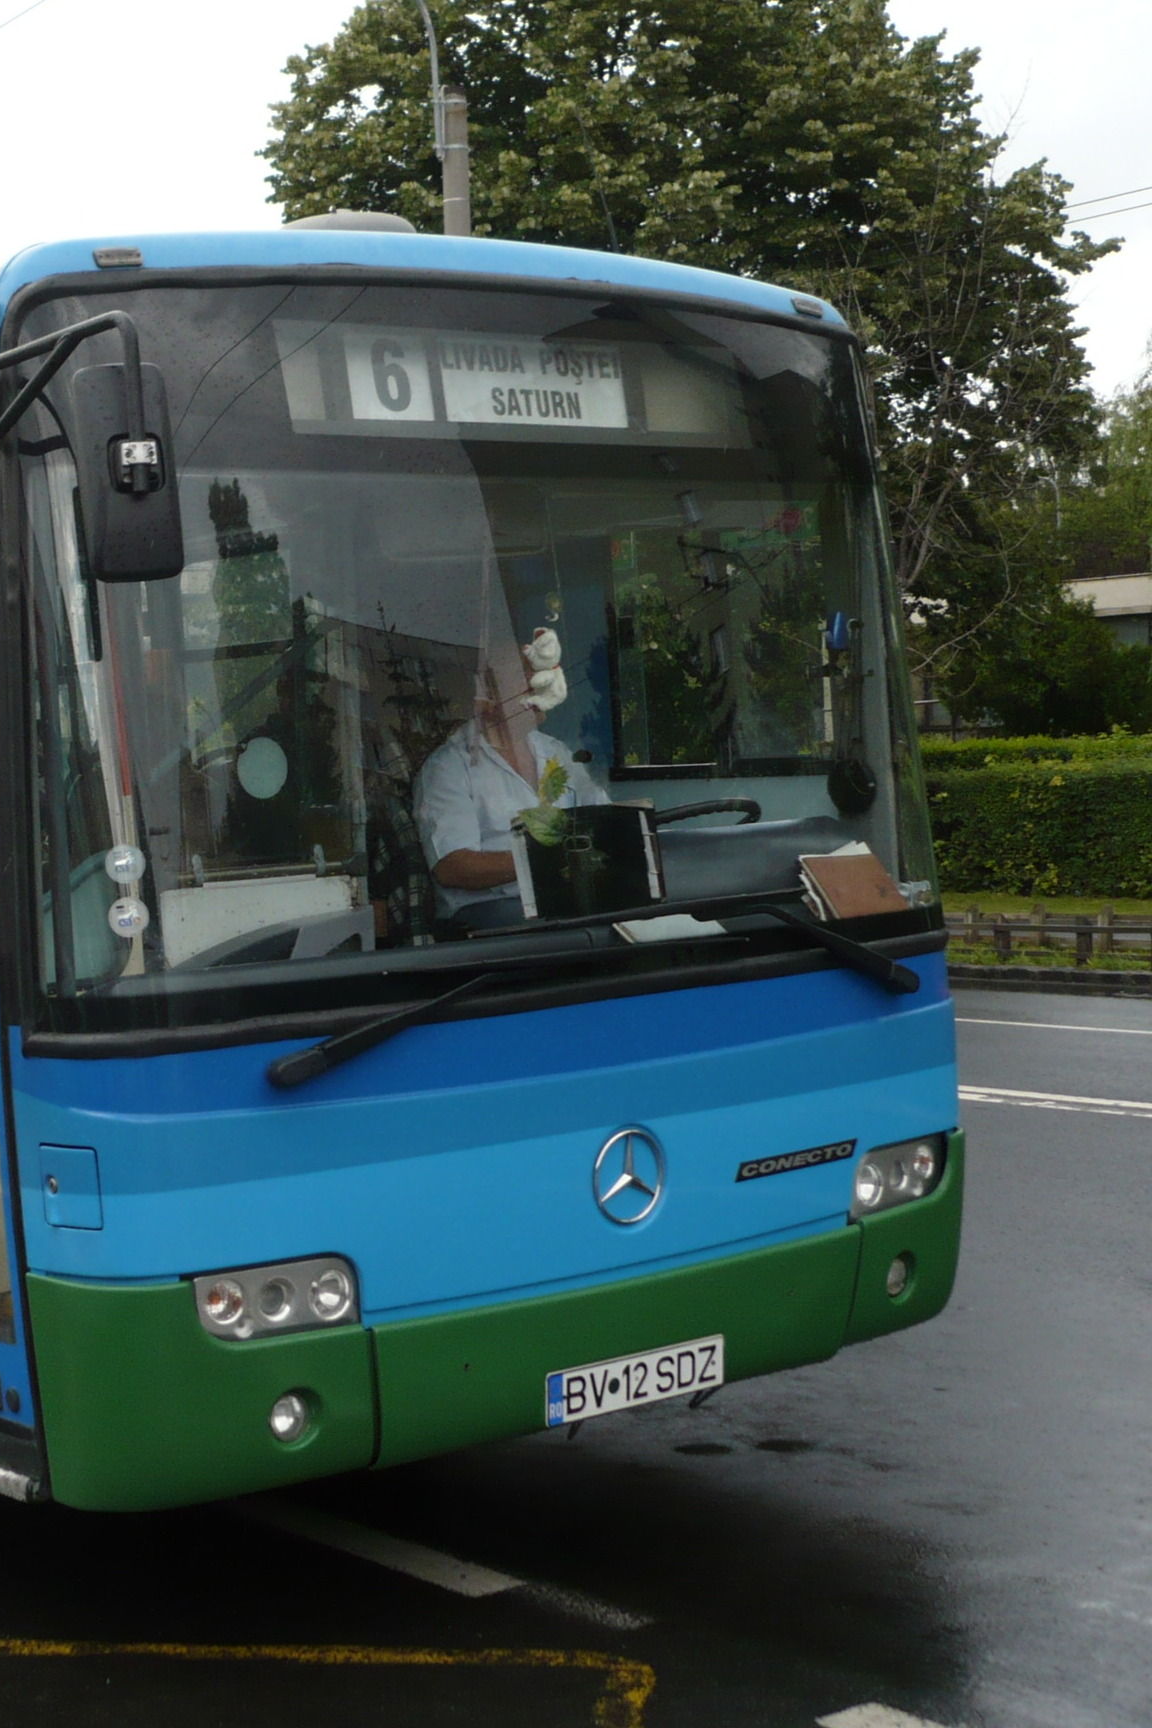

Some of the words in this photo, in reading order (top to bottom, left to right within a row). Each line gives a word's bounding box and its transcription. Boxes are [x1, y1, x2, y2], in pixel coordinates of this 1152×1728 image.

[440, 342, 526, 374] LIVADA
[370, 337, 412, 413] 6
[491, 386, 582, 419] SATURN
[741, 1143, 853, 1178] CONECTO
[549, 1403, 563, 1418] RO
